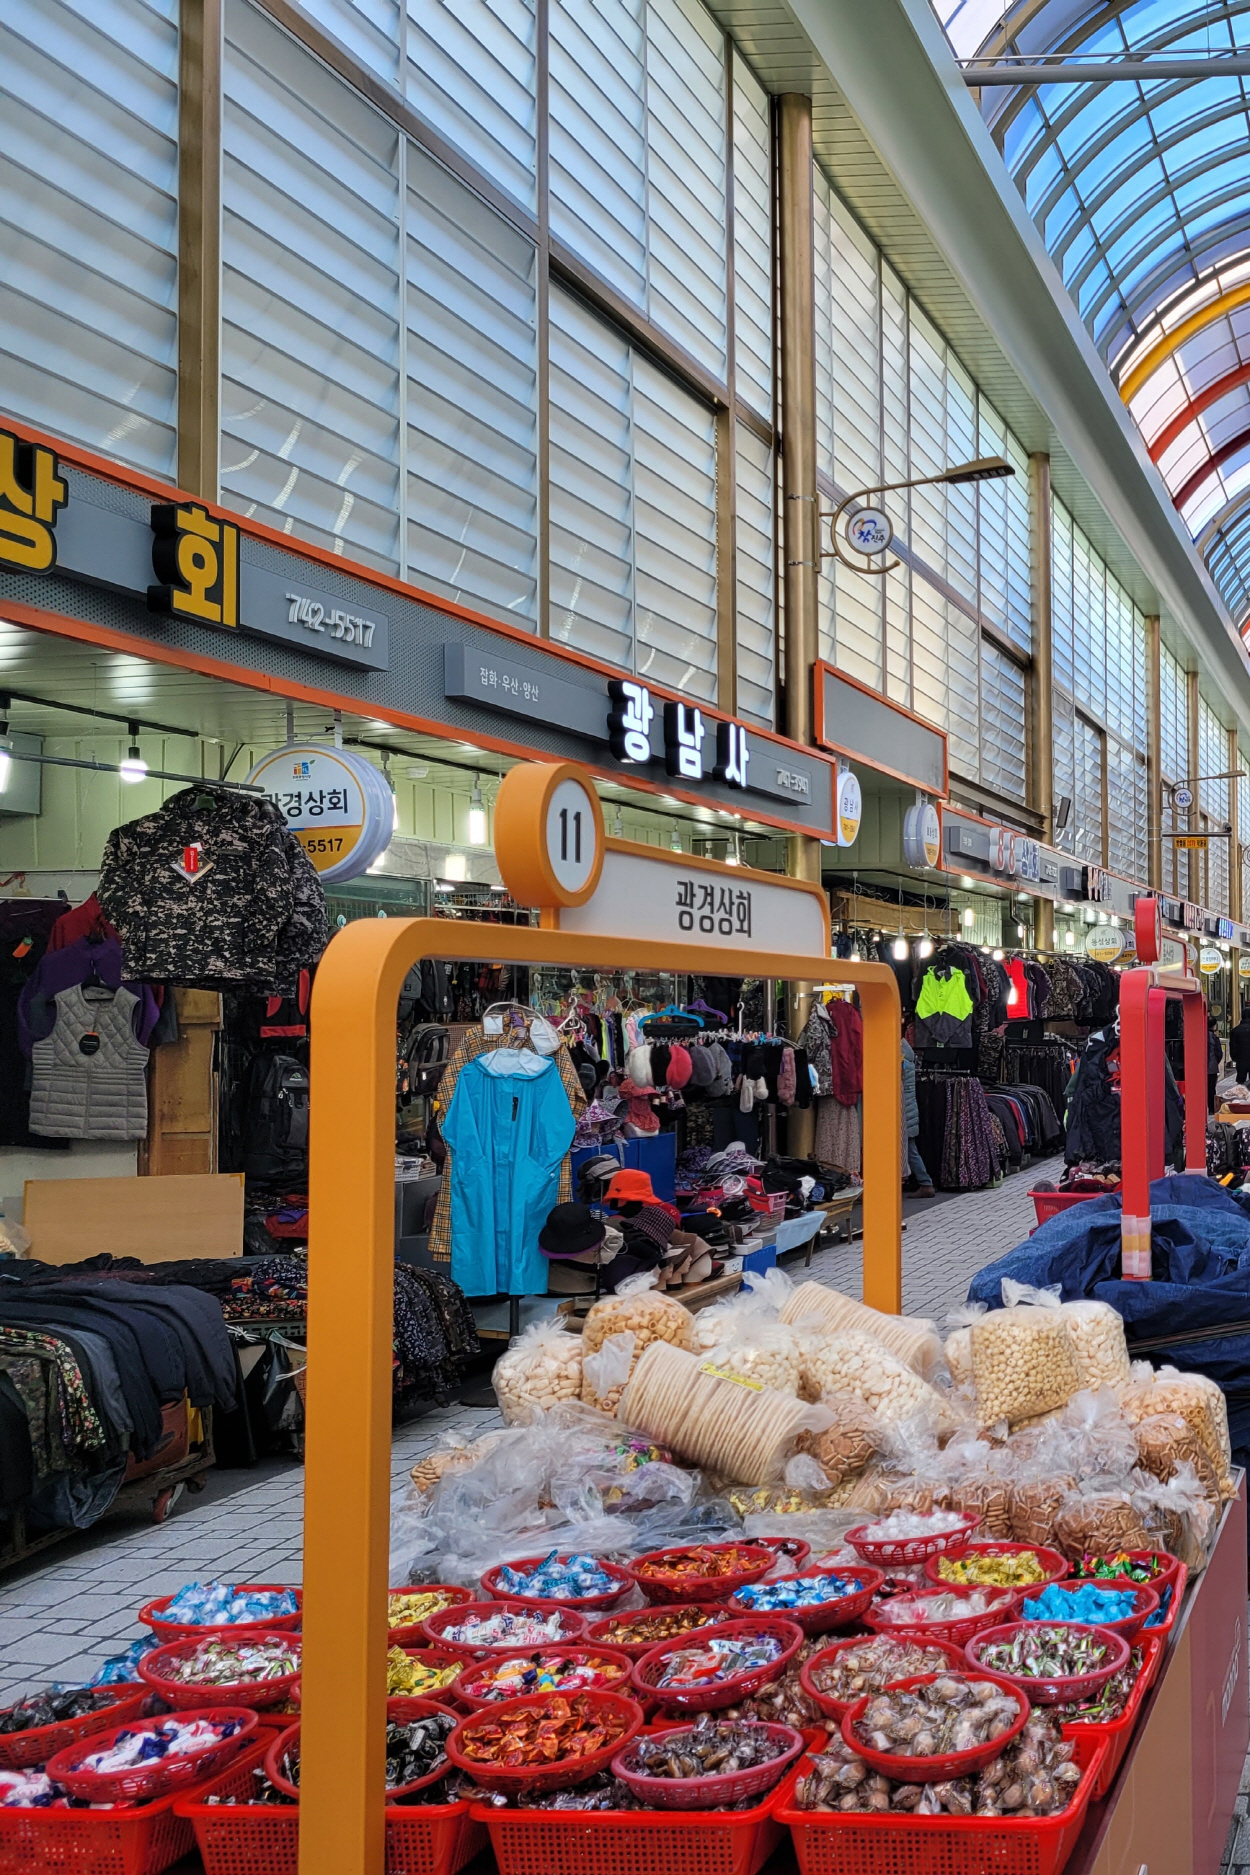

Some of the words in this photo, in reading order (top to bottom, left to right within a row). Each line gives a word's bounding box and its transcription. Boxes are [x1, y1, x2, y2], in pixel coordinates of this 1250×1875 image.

[286, 592, 376, 648] 742-5517
[622, 681, 750, 787] 광남사
[302, 838, 343, 853] -5517
[558, 808, 581, 864] 11
[675, 880, 752, 938] 광경상회
